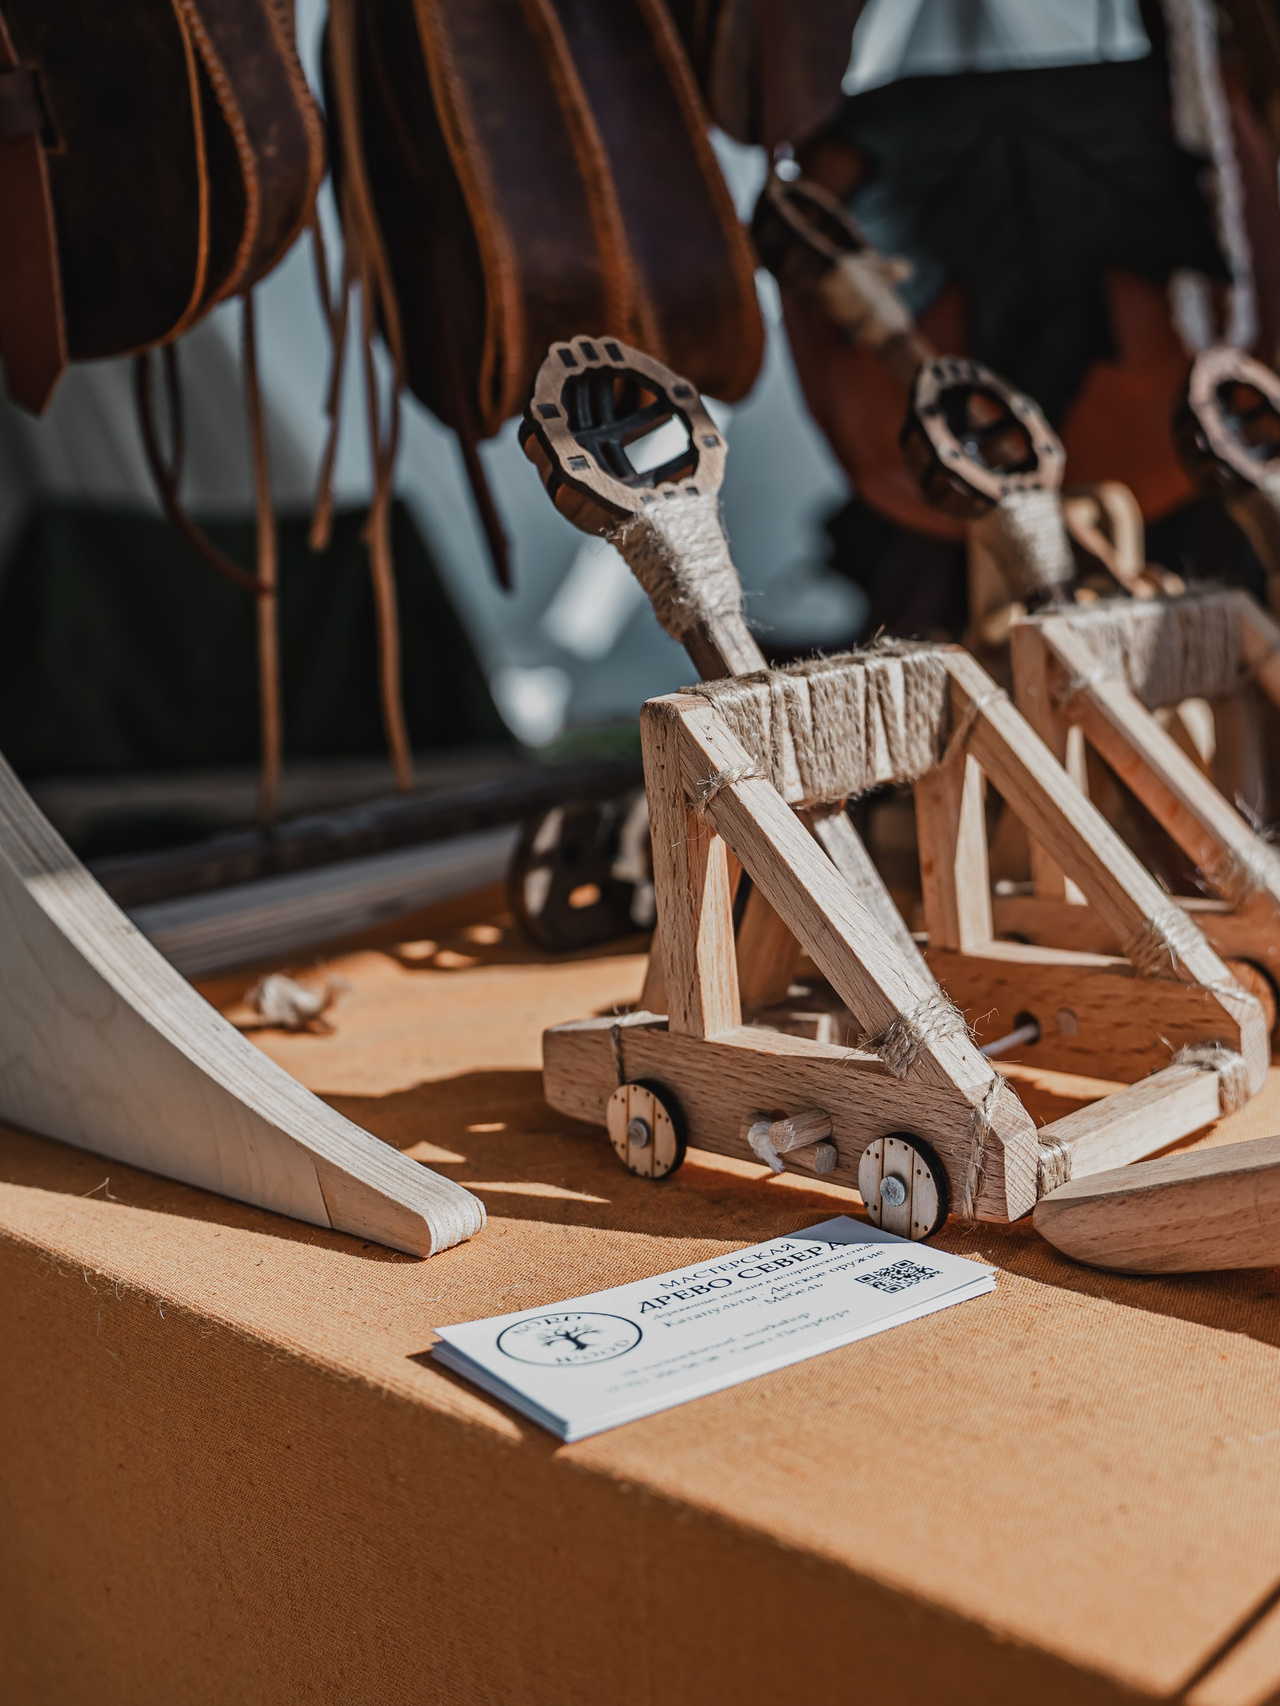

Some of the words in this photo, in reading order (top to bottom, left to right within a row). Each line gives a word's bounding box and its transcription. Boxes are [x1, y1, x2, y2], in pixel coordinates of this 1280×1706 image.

[639, 1278, 732, 1314] ДРЕВО
[737, 1242, 851, 1279] СЕВЕРА
[660, 1243, 796, 1289] МАСТЕРСКАЯ
[663, 1295, 758, 1327] Катапульты
[770, 1271, 828, 1295] Детское
[829, 1250, 886, 1273] оружие
[720, 1282, 763, 1299] изделия
[773, 1254, 845, 1282] историческом
[764, 1283, 824, 1304] Мебель
